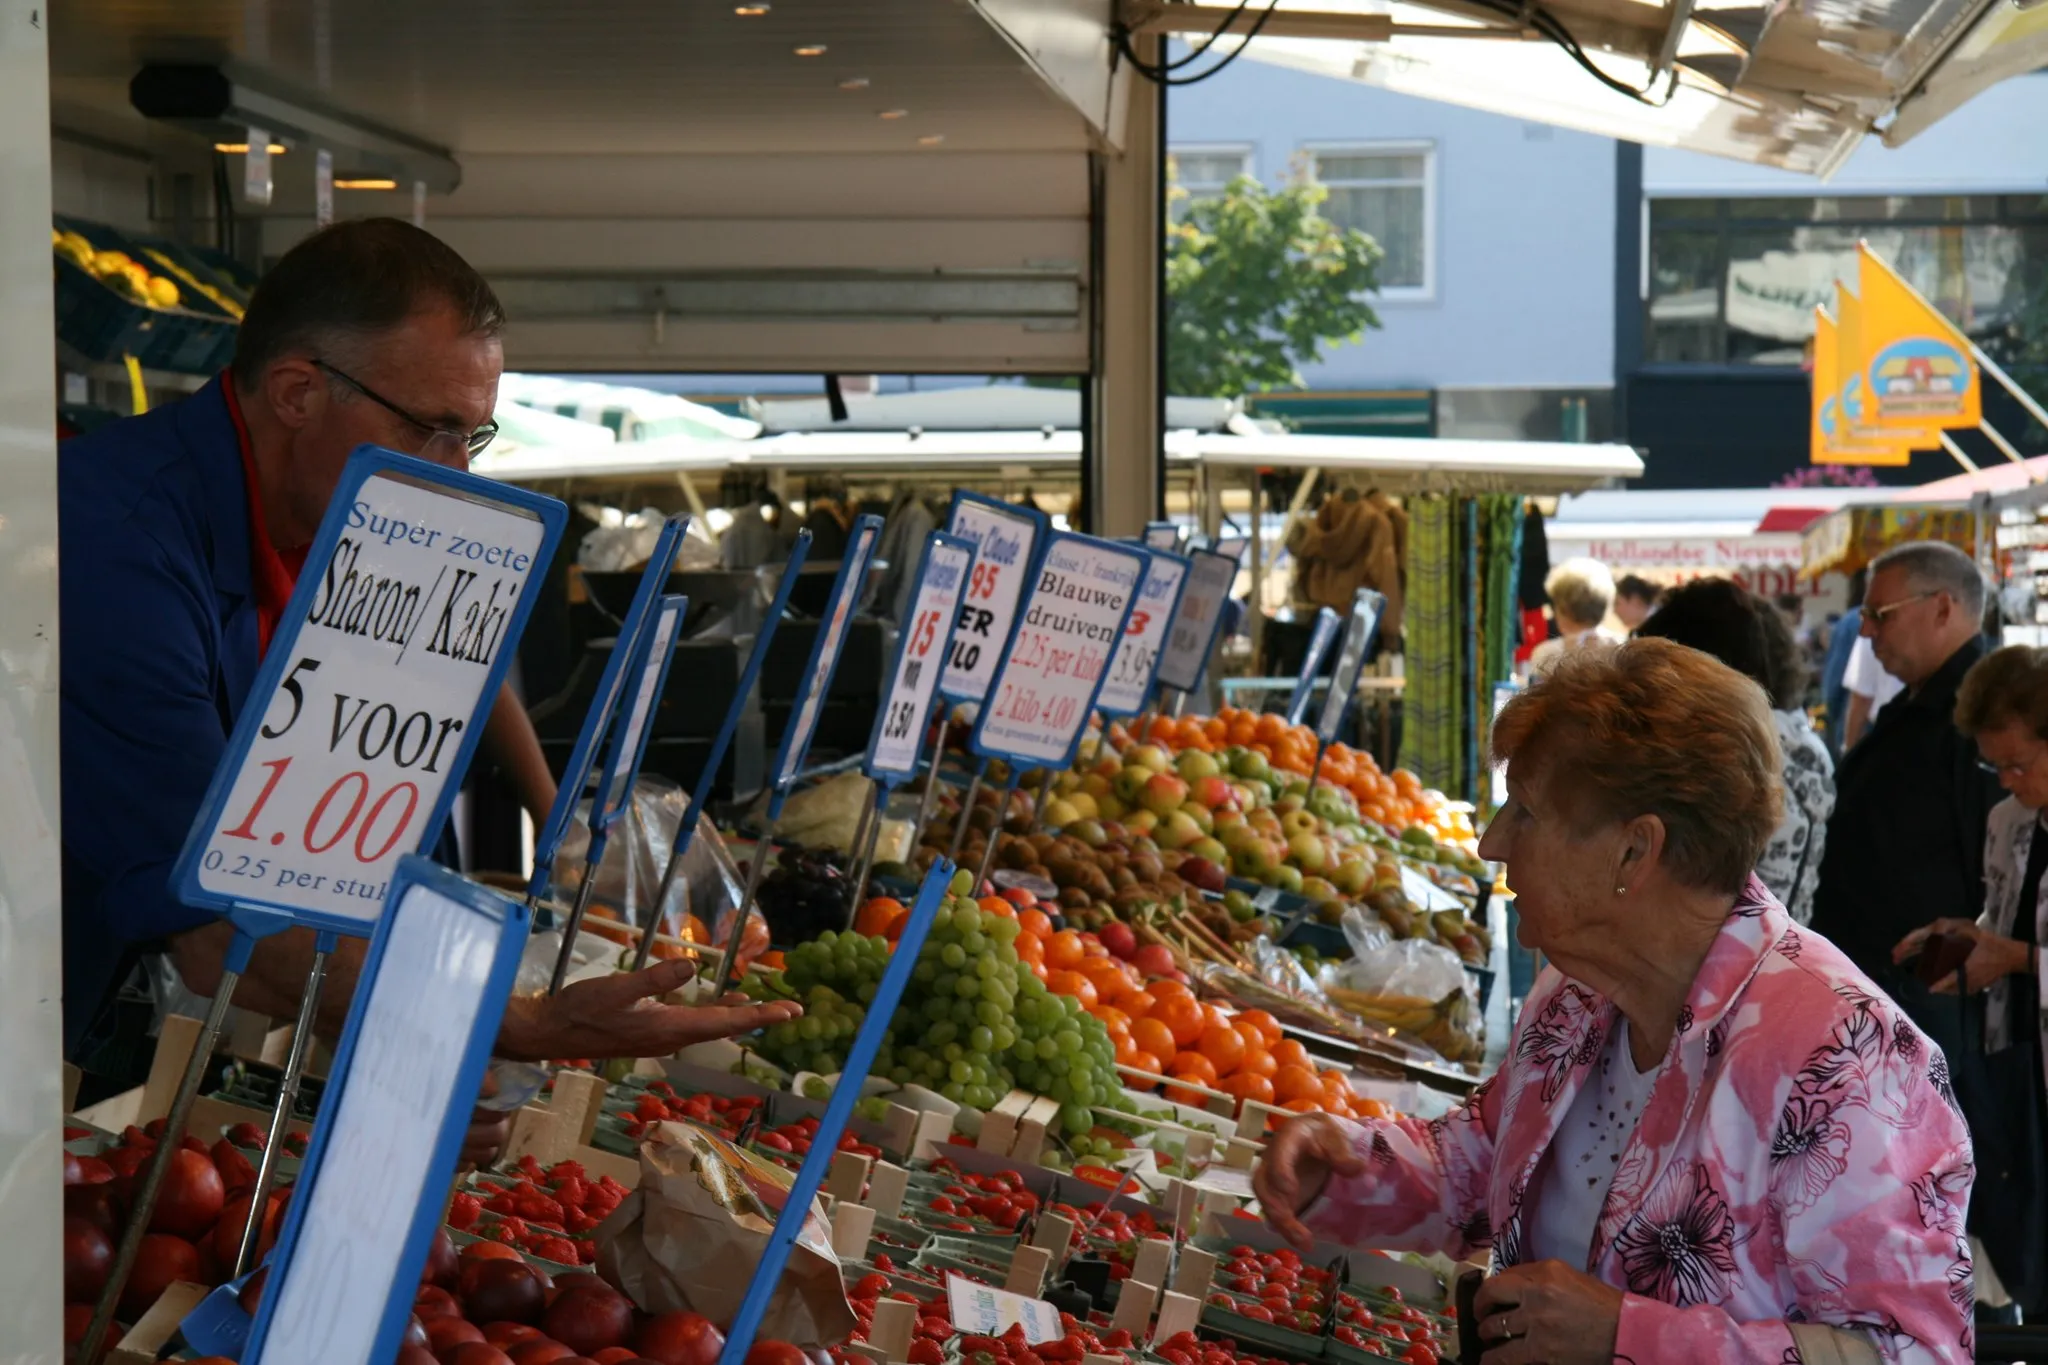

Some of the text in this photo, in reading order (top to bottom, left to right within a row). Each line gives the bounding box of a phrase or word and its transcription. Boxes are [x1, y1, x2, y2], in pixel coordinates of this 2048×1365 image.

[346, 501, 530, 573] Super zoete
[1037, 571, 1123, 611] Blauwe
[425, 568, 517, 665] Kaki
[908, 610, 941, 657] 15
[957, 604, 994, 638] ER
[1026, 605, 1115, 644] druiven
[948, 640, 981, 671] ILO
[1010, 631, 1104, 682] 2.25 per kilo
[261, 657, 463, 773] 5 voor
[995, 684, 1078, 730] 2 kilo 4.00
[222, 756, 418, 863] 1.00
[204, 850, 270, 879] 0.25
[275, 867, 327, 888] per
